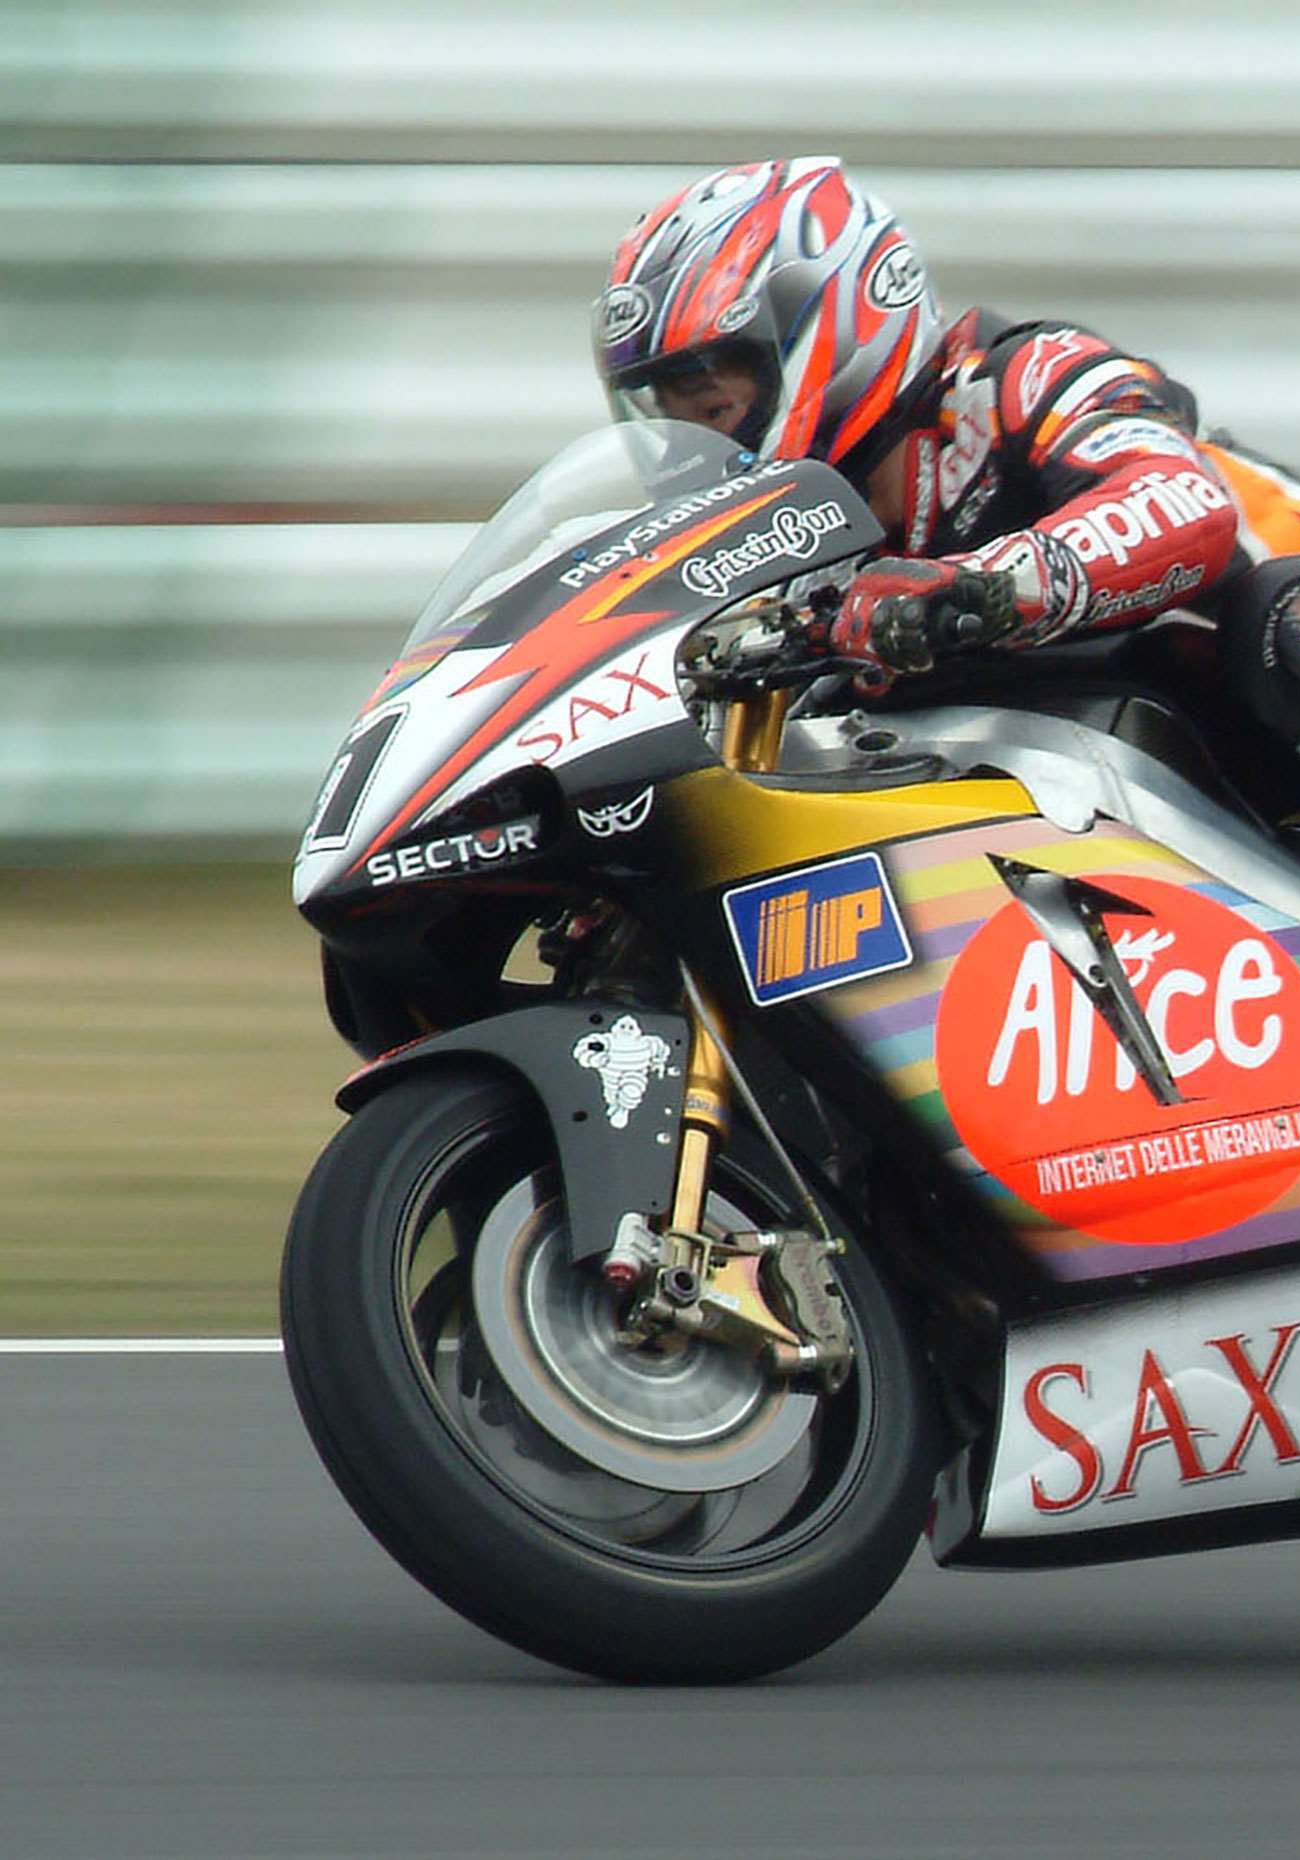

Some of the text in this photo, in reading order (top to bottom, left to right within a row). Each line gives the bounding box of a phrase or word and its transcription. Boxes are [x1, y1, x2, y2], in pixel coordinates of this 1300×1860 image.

[1051, 471, 1231, 567] aprilia
[516, 652, 671, 767] SAX
[366, 823, 537, 887] SECTOR
[1036, 1143, 1138, 1196] INTERNET
[1138, 1131, 1203, 1176] DELLE
